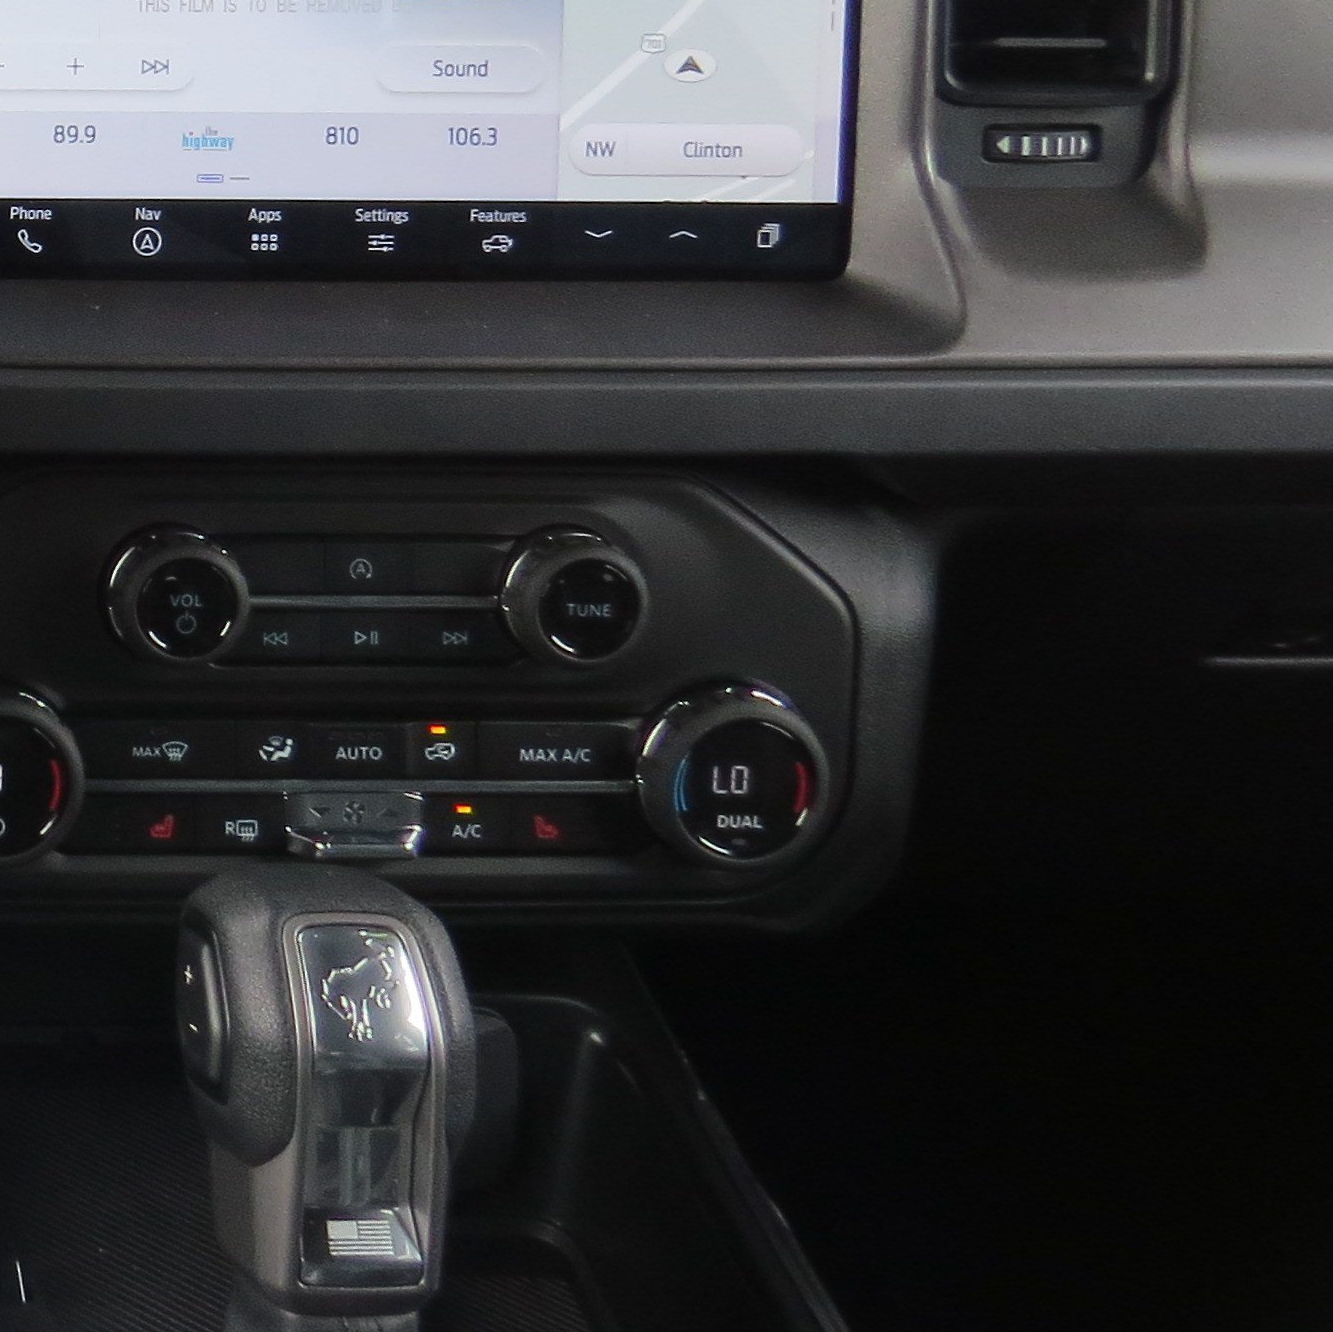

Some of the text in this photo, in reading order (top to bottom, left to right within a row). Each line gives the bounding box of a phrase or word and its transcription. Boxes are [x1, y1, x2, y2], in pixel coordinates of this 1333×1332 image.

[433, 59, 489, 78] Sound
[53, 125, 96, 144] 89.9
[182, 132, 234, 150] highway
[325, 126, 360, 146] 810
[447, 127, 498, 147] 106.3
[585, 142, 616, 159] NW
[683, 140, 743, 159] Clinton
[10, 206, 52, 221] Phone
[135, 207, 161, 221] Nav
[248, 208, 282, 224] Apps
[355, 208, 409, 225] Settings
[470, 209, 527, 223] Features
[170, 594, 203, 607] VOL
[567, 603, 612, 618] TUNE
[133, 747, 161, 757] MAX
[336, 747, 383, 760] AUTO
[519, 748, 591, 763] MAX A/C
[717, 815, 763, 829] DUAL
[452, 823, 481, 838] A/C
